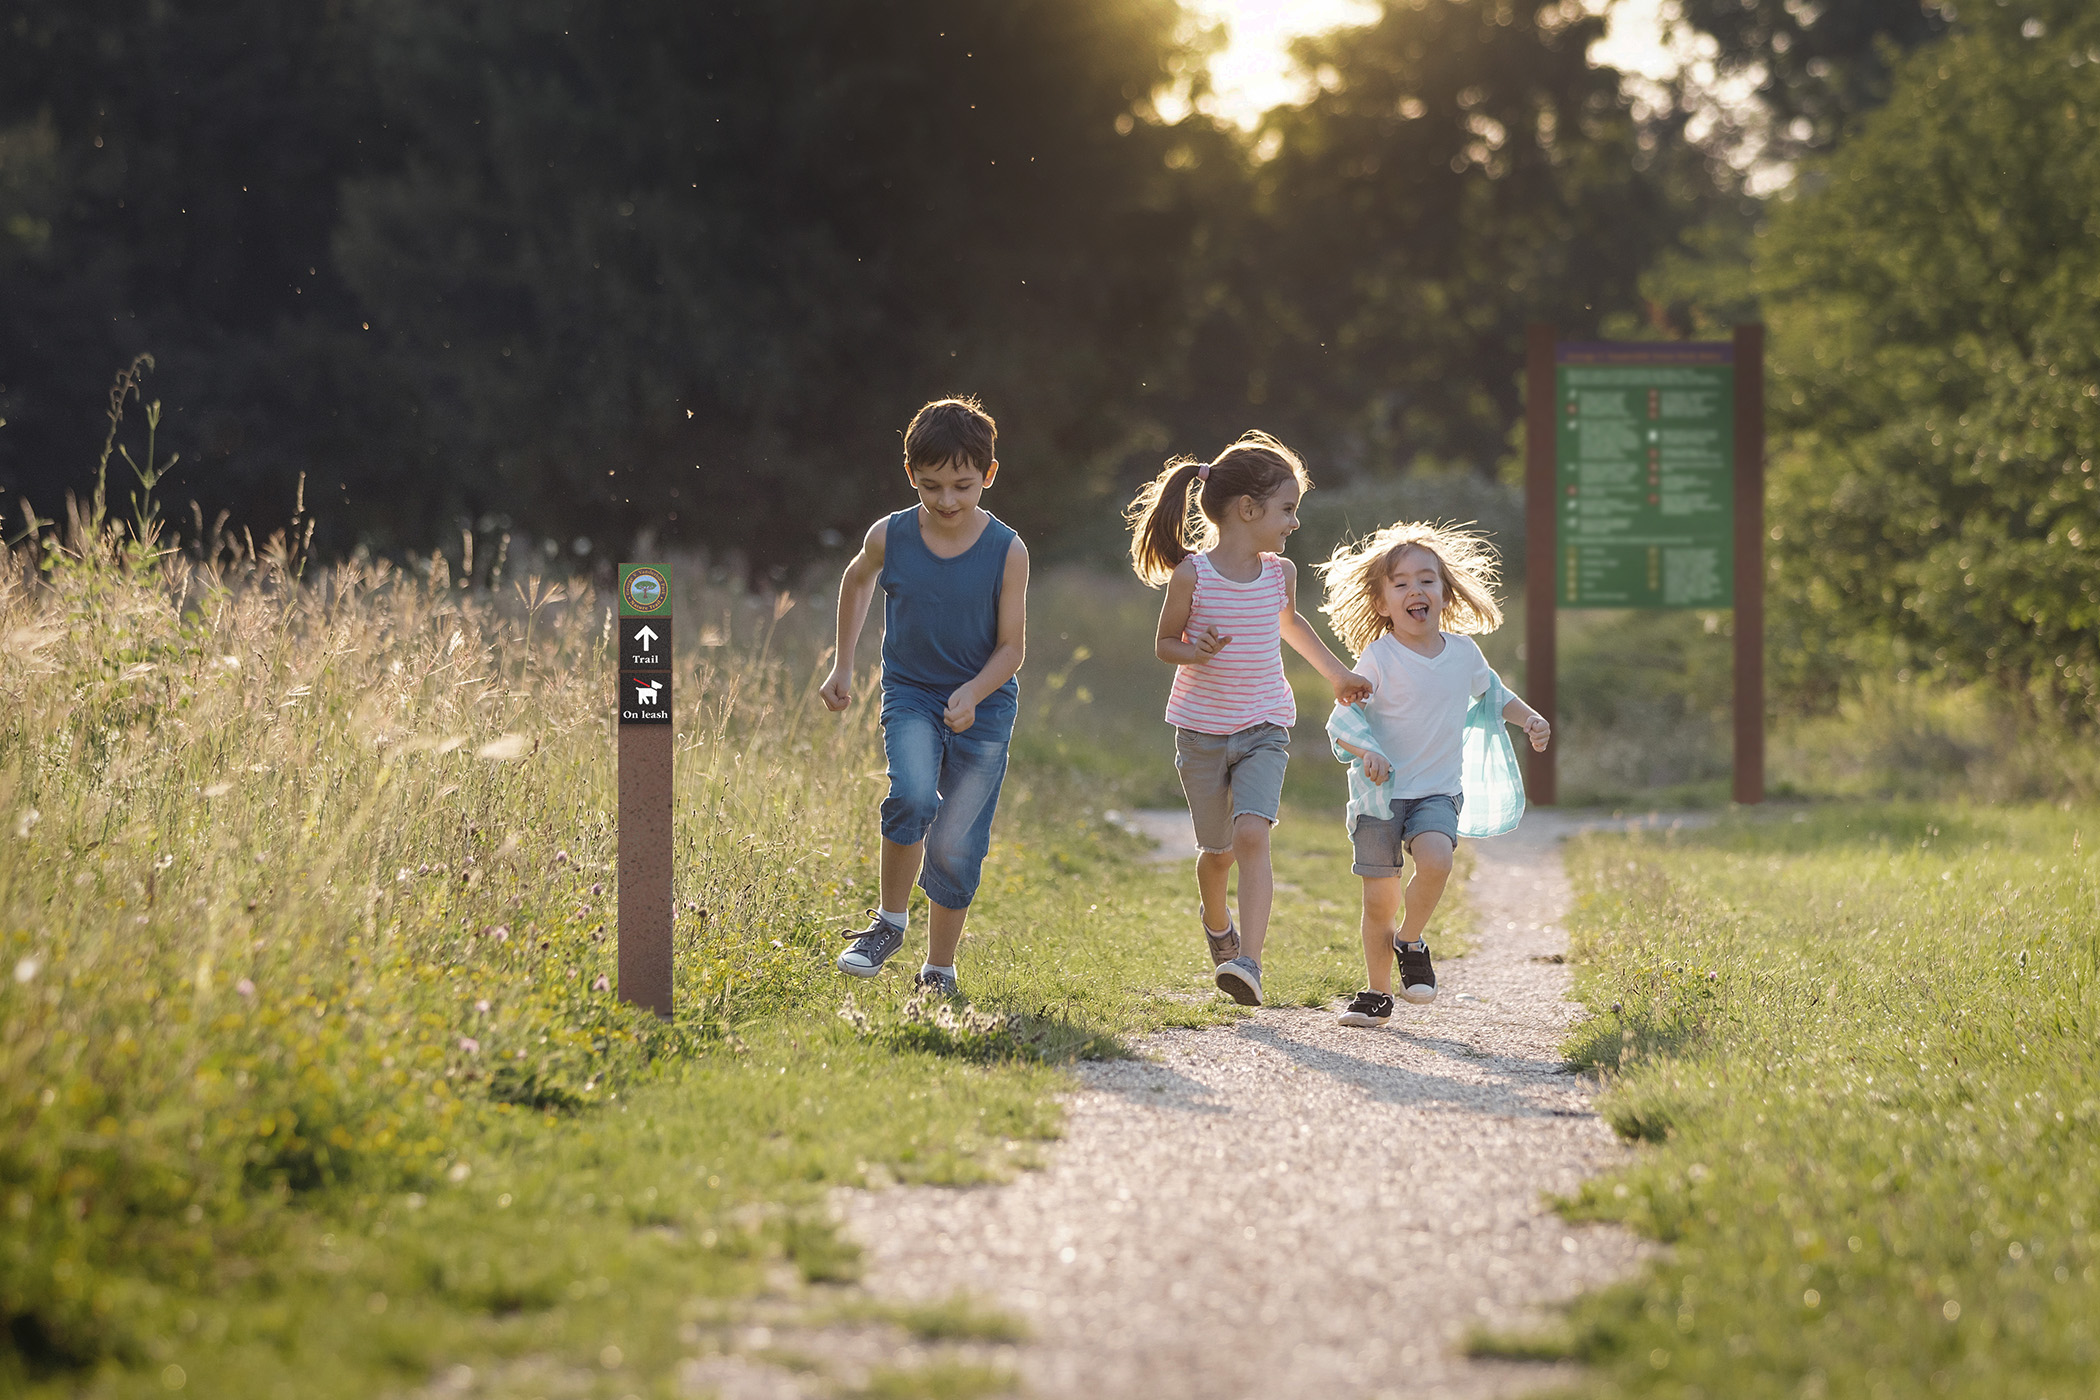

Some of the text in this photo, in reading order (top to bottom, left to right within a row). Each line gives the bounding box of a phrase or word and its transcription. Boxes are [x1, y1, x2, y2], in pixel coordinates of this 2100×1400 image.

[632, 655, 659, 664] Trail
[623, 710, 668, 719] On leash
